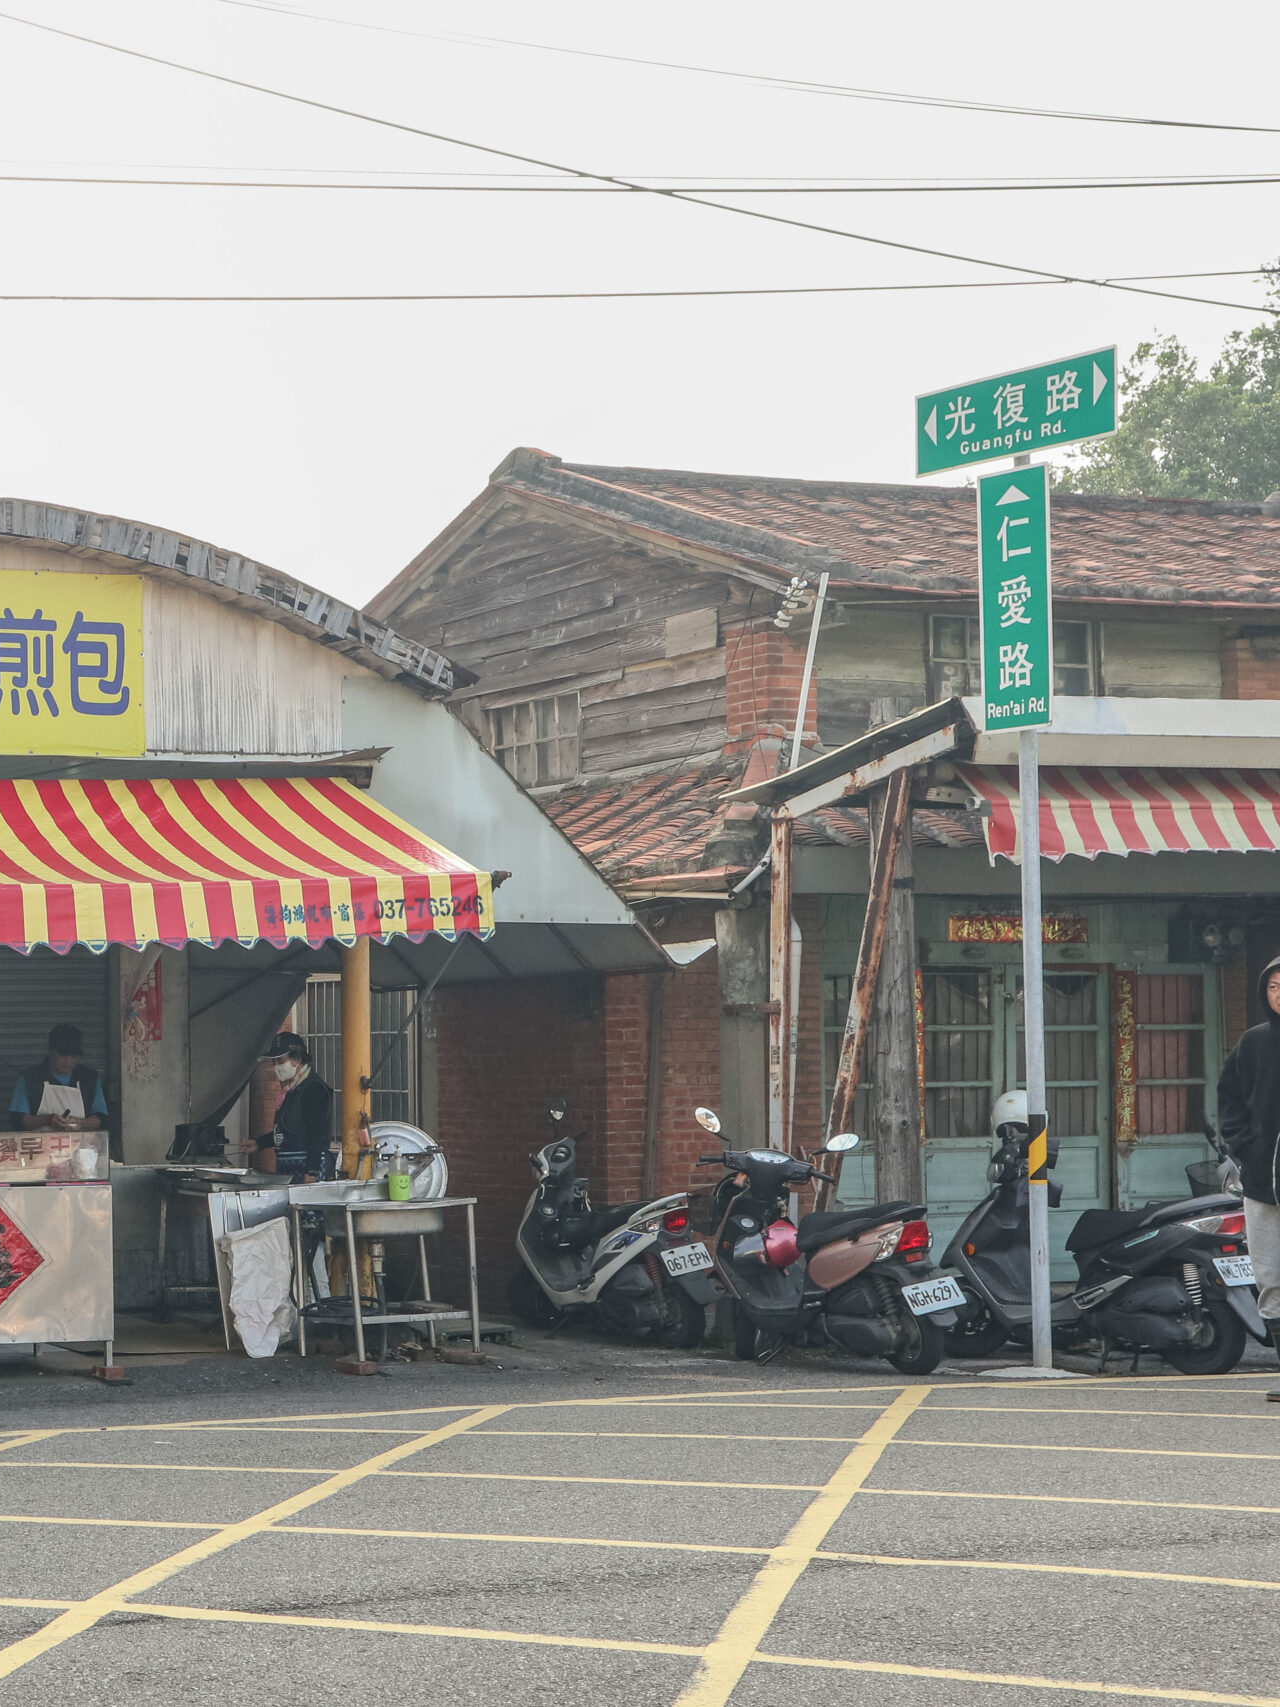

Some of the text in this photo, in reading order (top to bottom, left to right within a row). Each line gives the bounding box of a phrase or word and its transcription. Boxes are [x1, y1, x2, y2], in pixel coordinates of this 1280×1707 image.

[944, 370, 1083, 441] 光復路
[960, 418, 1067, 456] Guangfu Rd.
[997, 515, 1034, 690] 仁愛路
[987, 695, 1047, 719] Ren'ai Rd.
[373, 895, 484, 920] 037-765246
[907, 1283, 960, 1309] NGH-6291
